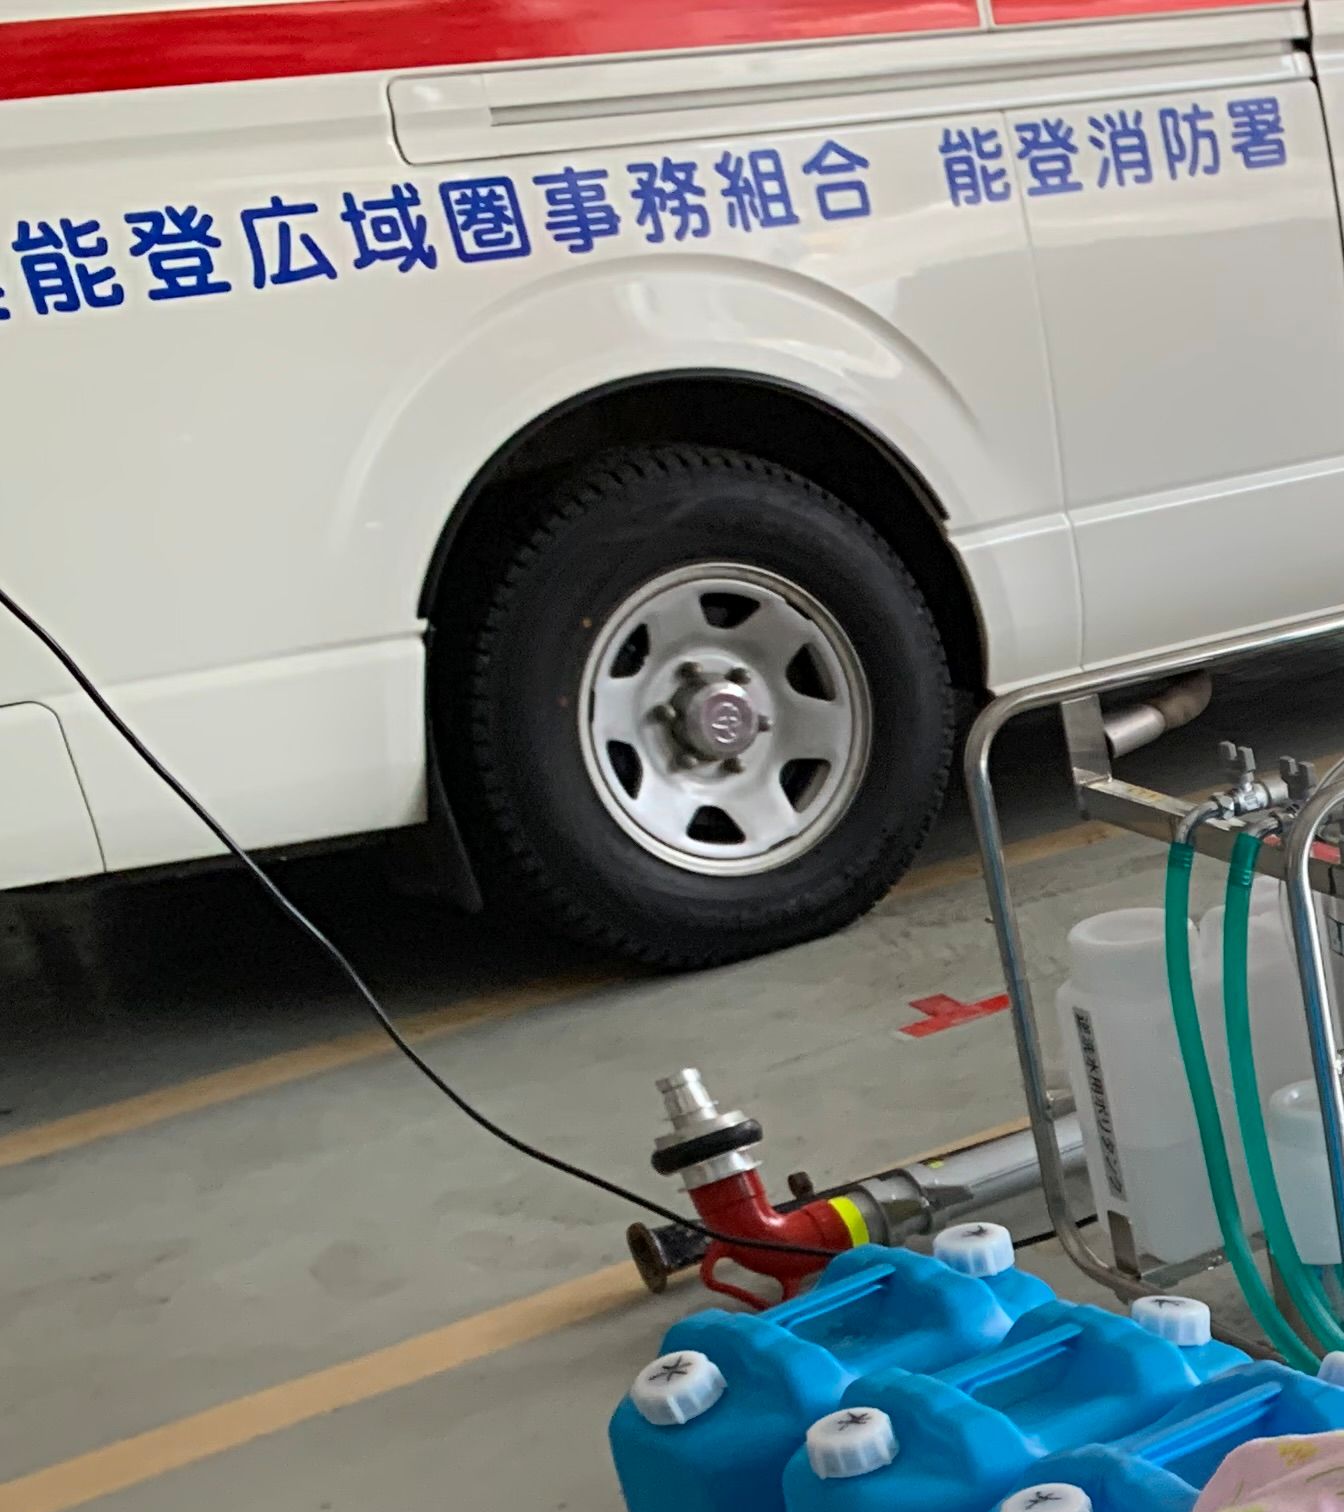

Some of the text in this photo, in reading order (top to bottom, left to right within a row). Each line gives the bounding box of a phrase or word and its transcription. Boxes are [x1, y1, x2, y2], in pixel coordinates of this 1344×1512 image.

[0, 96, 1288, 320] 能登広域圏事務組合 能登消防署
